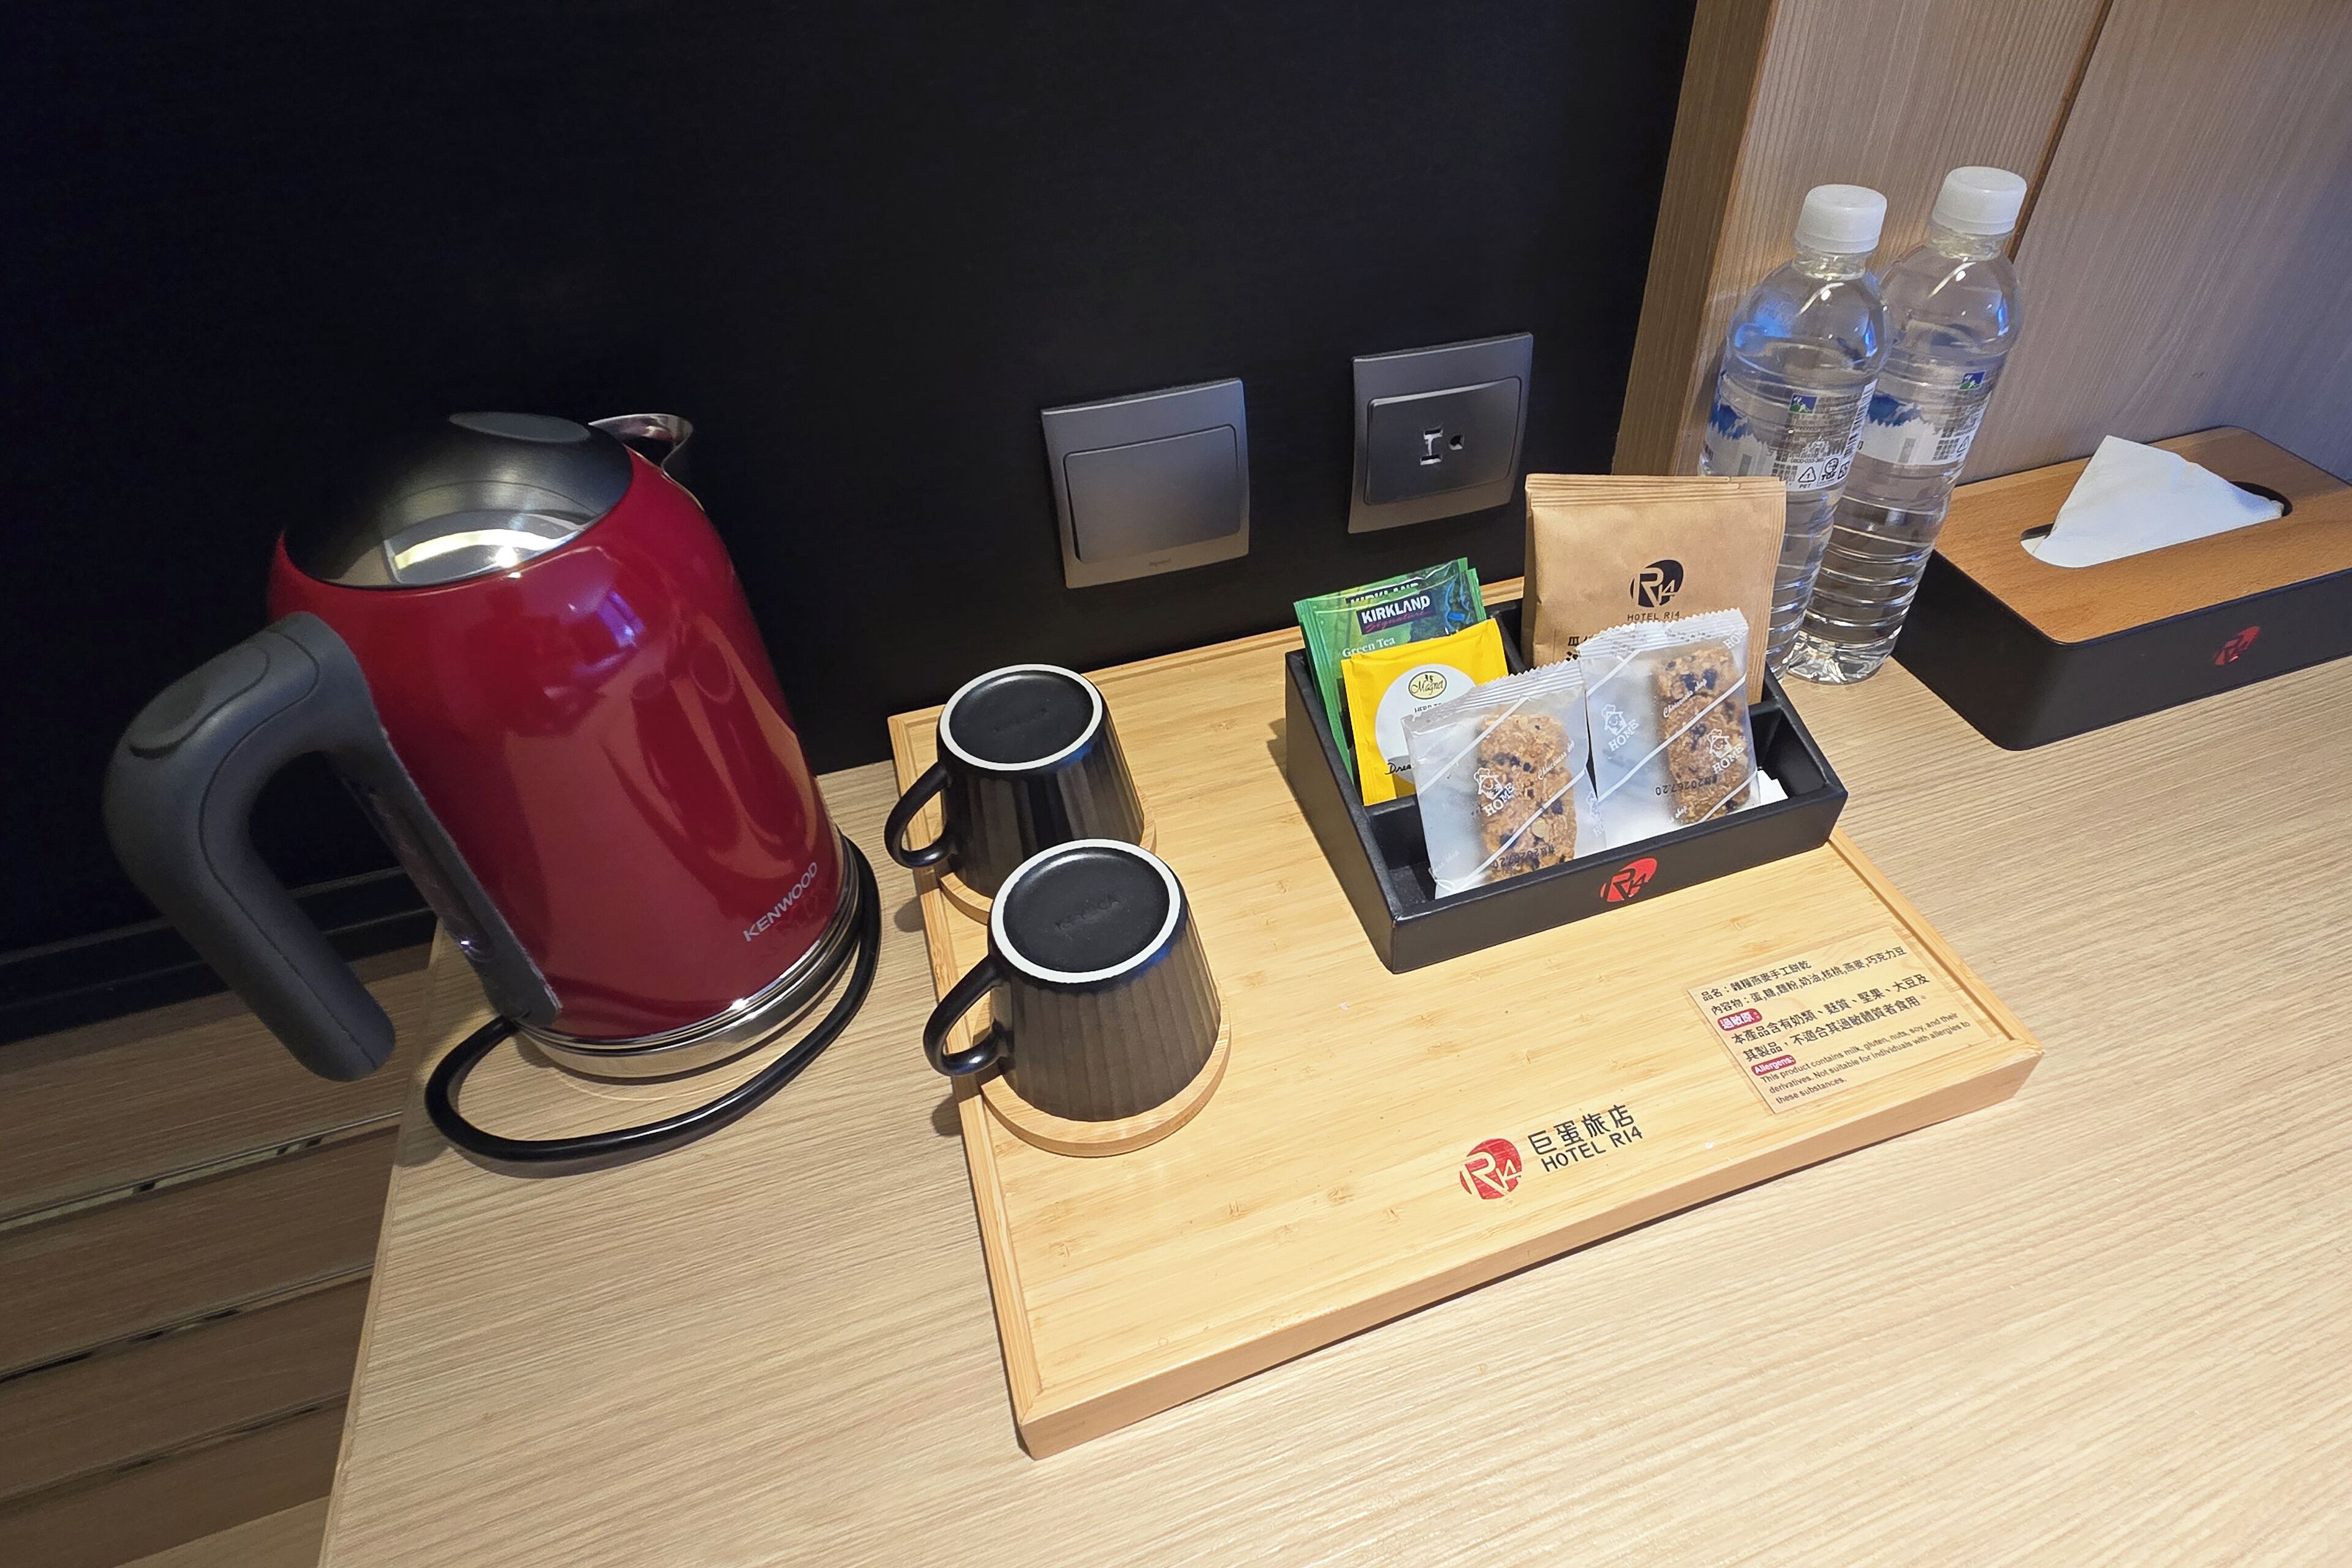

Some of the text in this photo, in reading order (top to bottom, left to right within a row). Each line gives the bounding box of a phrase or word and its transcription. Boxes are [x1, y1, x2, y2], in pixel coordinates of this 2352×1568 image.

[1361, 595, 1431, 624] KIRKLAND
[1627, 612, 1659, 621] HOTEL
[1342, 637, 1395, 658] Green Tea
[1608, 718, 1640, 752] HOME
[1712, 742, 1744, 774] HOME
[1482, 782, 1515, 816] HOME
[743, 862, 818, 942] KENWOOD
[1760, 1012, 1959, 1083] This product contains milk, gluten, nuts, soy, and their
[1769, 1074, 1814, 1094] derivatives.
[1813, 1068, 1830, 1079] Not
[1830, 1059, 1860, 1074] suitable
[1858, 1054, 1872, 1063] for
[1912, 1035, 1930, 1045] with
[1931, 1023, 1962, 1040] allergies
[1961, 1020, 1971, 1028] to
[1754, 1056, 1795, 1074] Allergens:
[1776, 1076, 1847, 1104] these substances.
[1528, 1104, 1635, 1156] 巨蛋旅店
[1540, 1140, 1607, 1172] HOTEL
